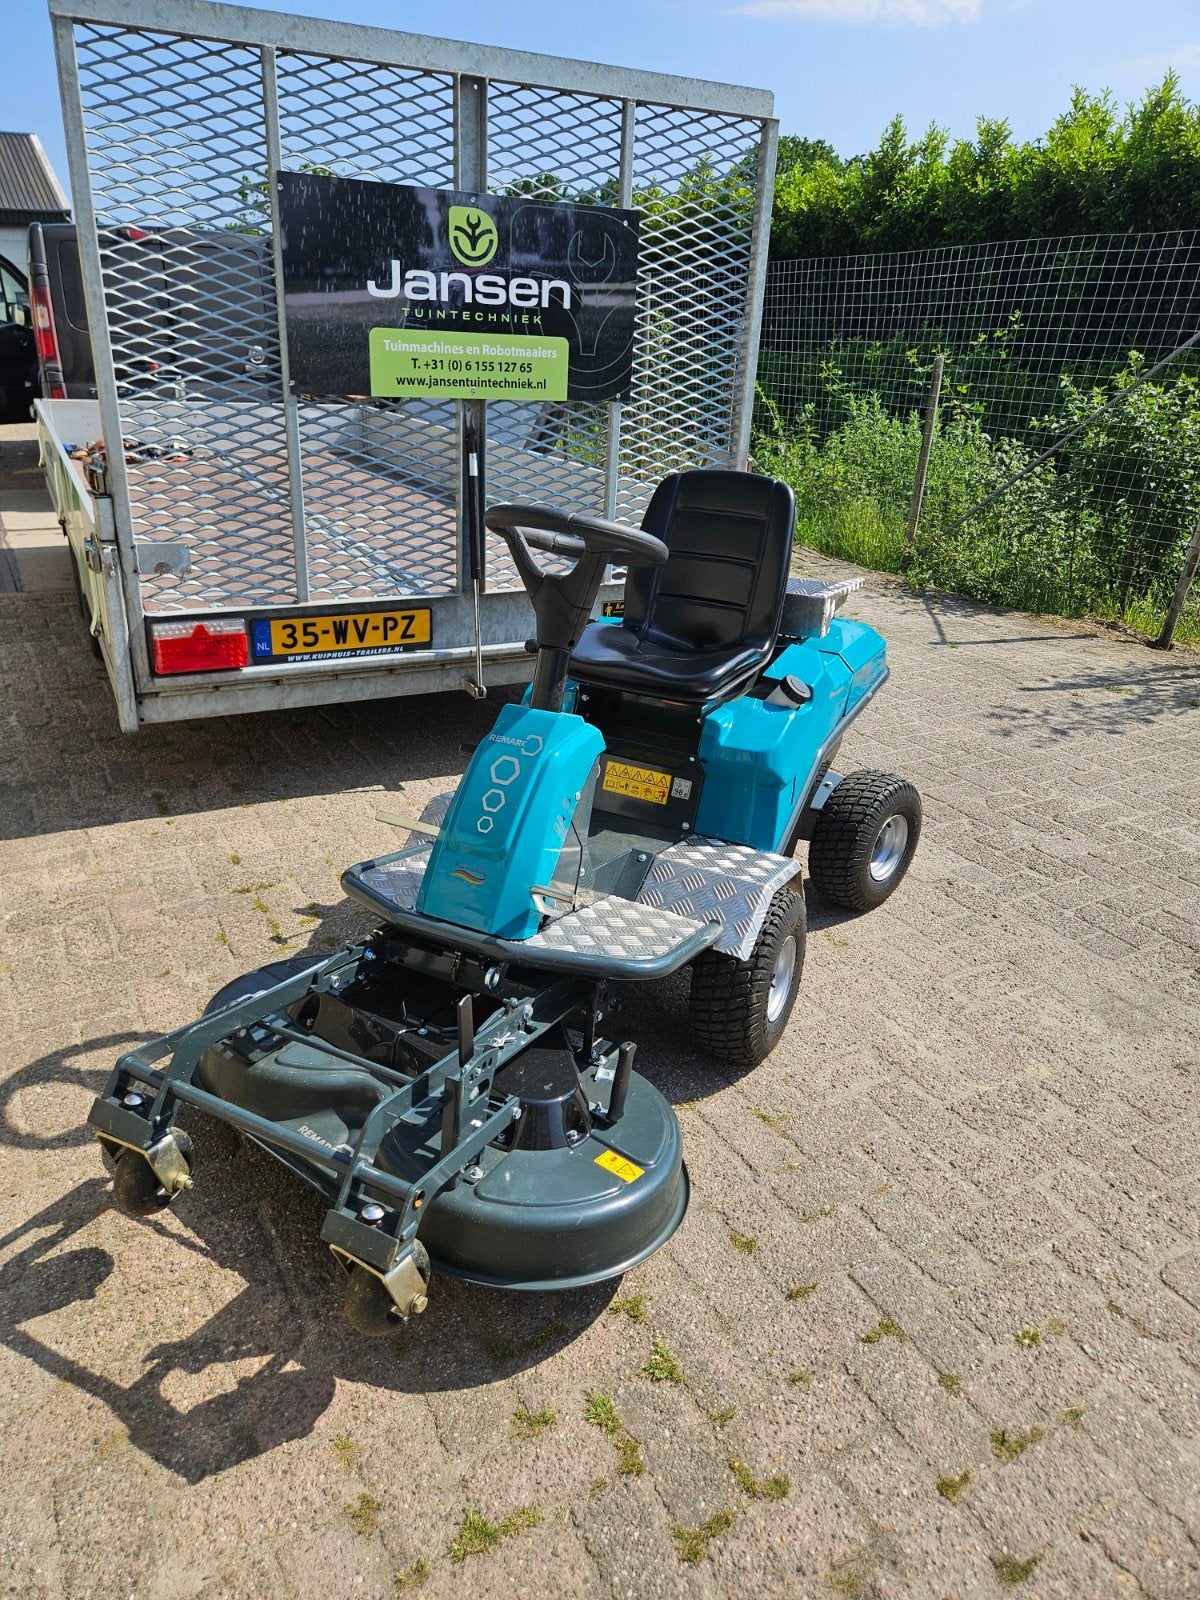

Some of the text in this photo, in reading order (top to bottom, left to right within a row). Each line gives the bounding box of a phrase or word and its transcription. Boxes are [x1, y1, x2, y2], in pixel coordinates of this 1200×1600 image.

[367, 259, 571, 309] Jansen
[401, 307, 542, 325] TUINTECHNIEK
[383, 339, 557, 358] Tuinmachines en Robotmaaiers
[411, 358, 533, 373] T. +31 (0) 6 155 127 65
[396, 375, 547, 390] www.jansentuintechniek.nl
[281, 614, 416, 649] 35-WV-PZ
[257, 642, 270, 651] NL
